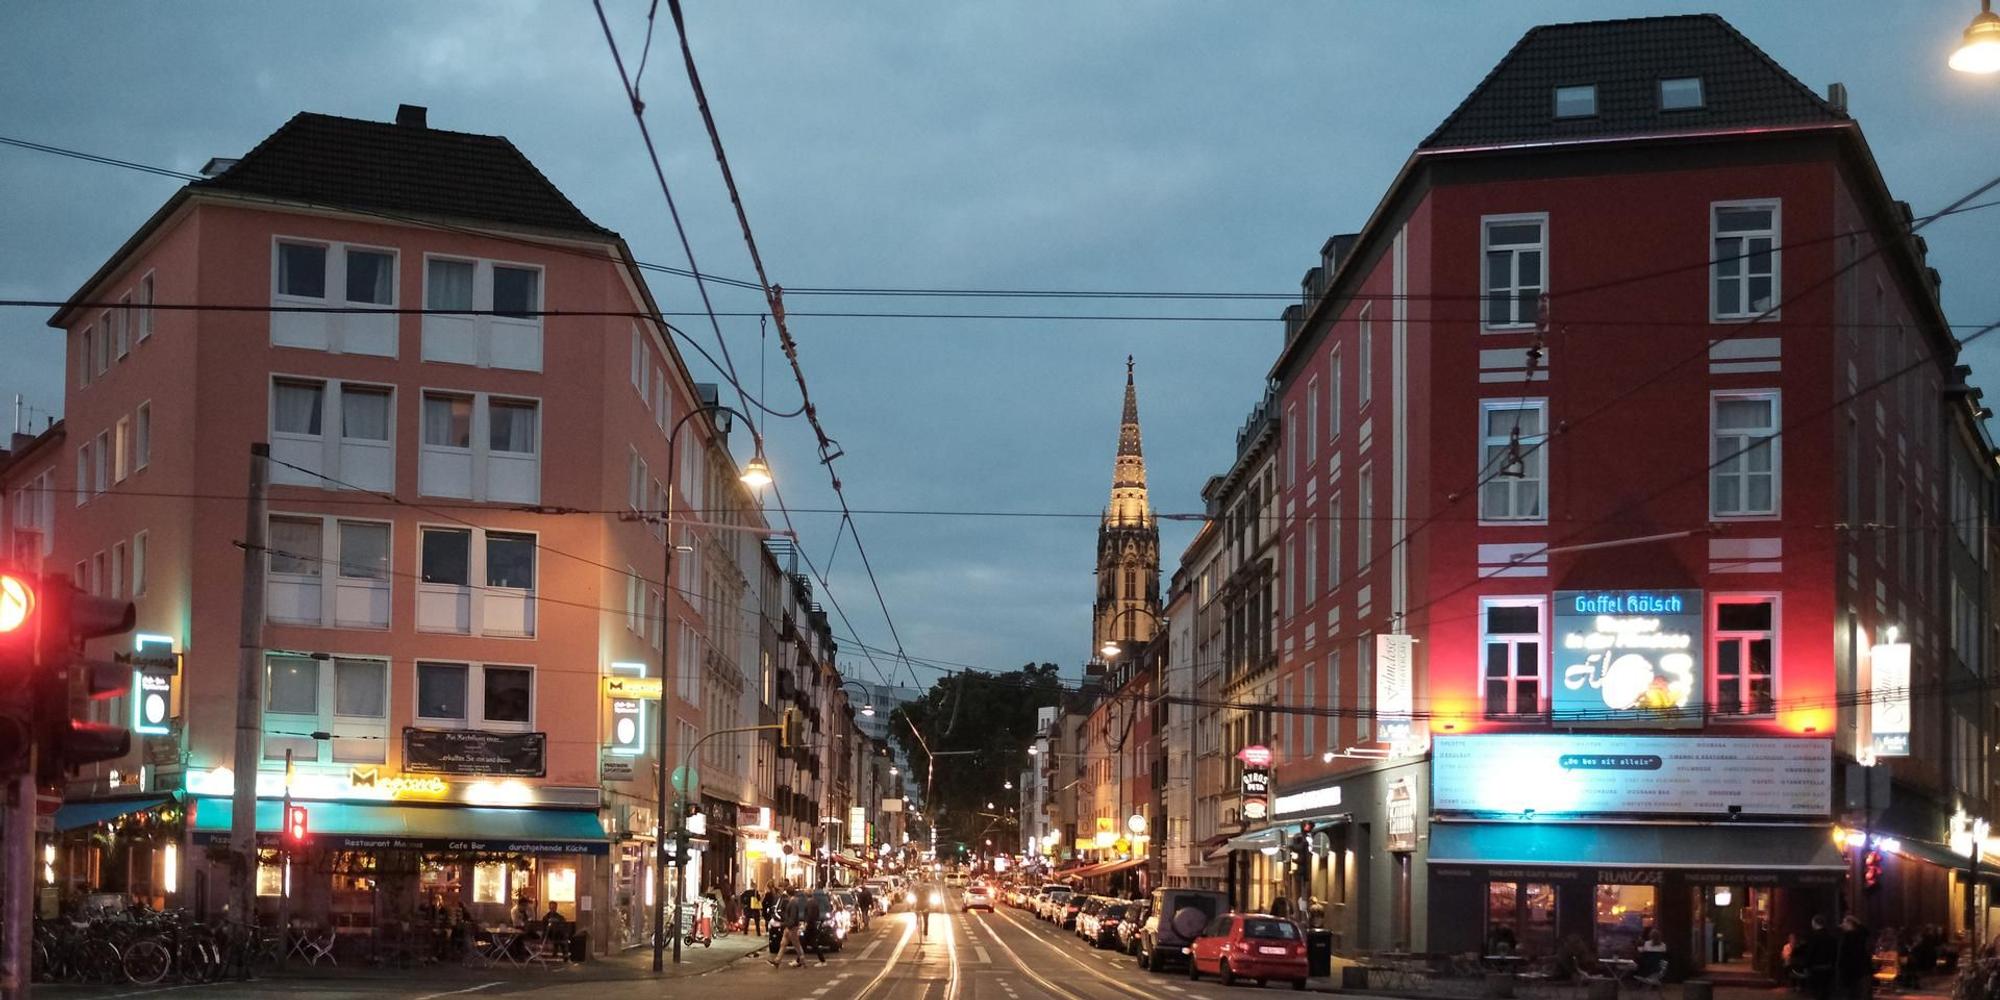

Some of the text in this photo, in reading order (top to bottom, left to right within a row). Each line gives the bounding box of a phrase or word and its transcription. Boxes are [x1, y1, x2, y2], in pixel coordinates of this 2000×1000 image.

[1575, 595, 1681, 612] Gaffel Kölsch
[1243, 772, 1269, 785] GYROS
[344, 839, 391, 848] Restaurant
[471, 841, 486, 850] Bar
[508, 843, 588, 853] durchgehende Küche
